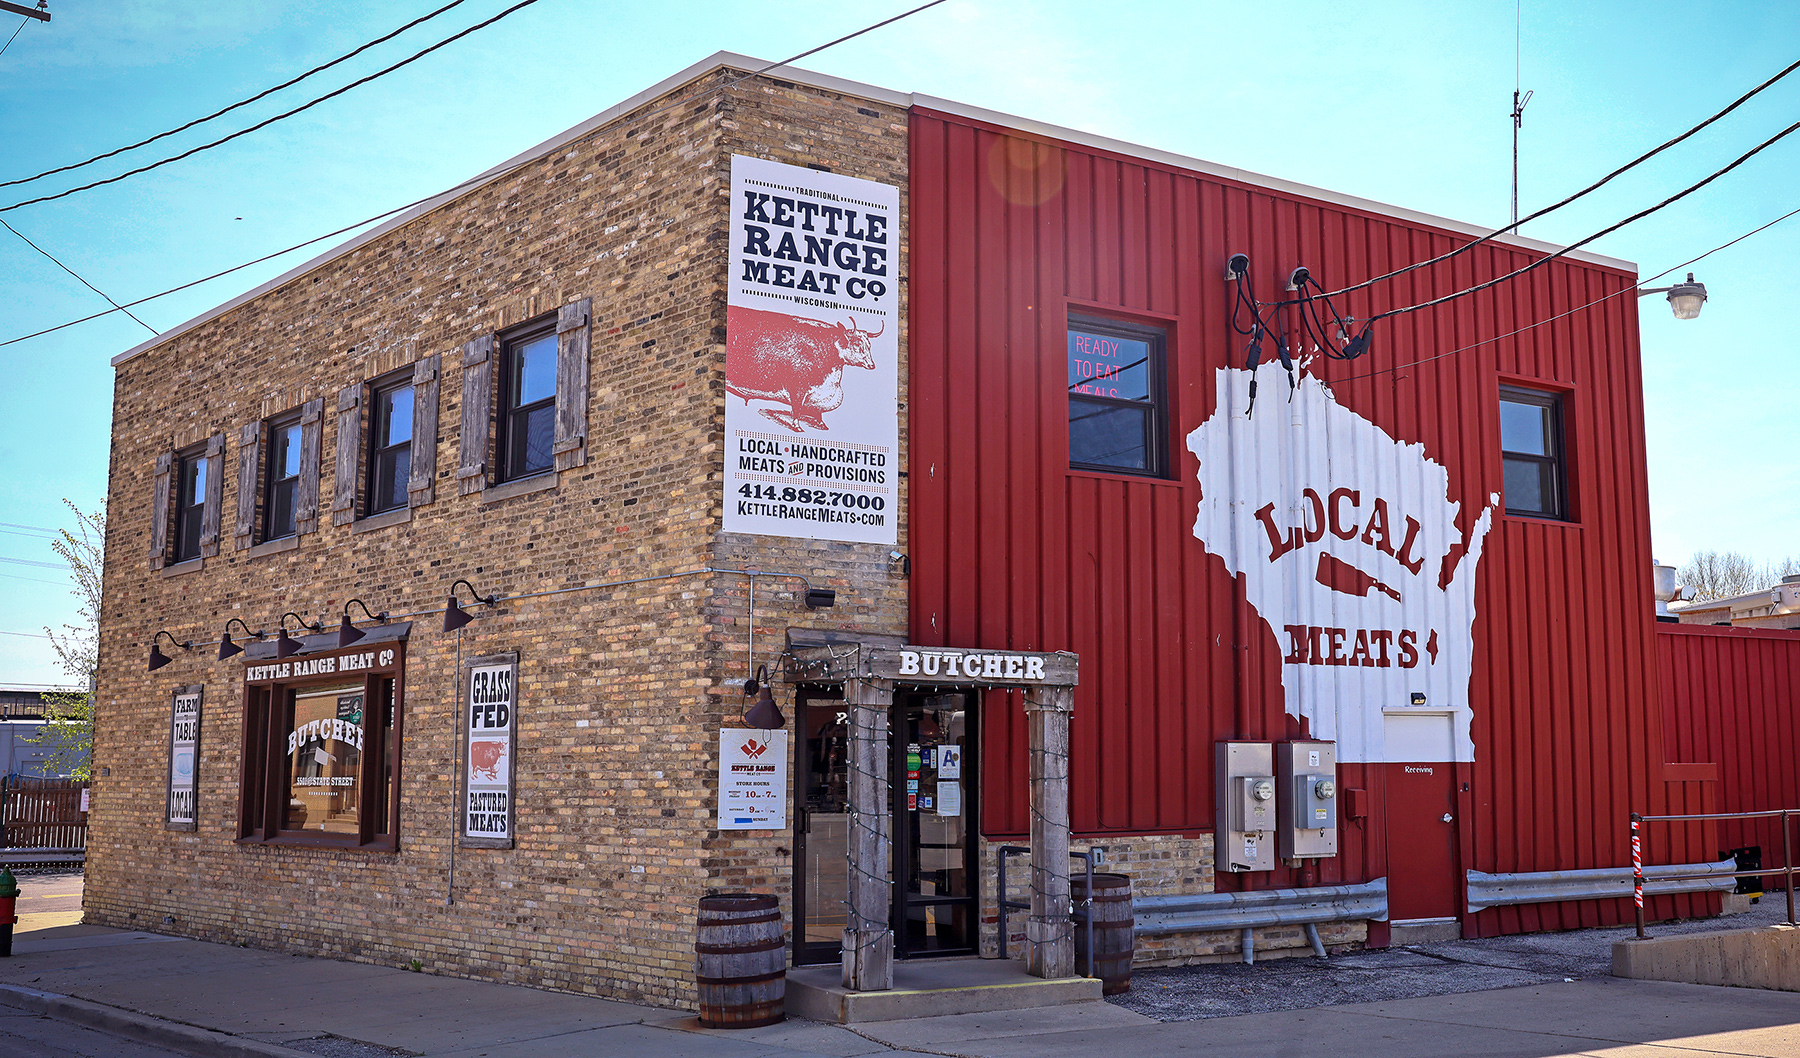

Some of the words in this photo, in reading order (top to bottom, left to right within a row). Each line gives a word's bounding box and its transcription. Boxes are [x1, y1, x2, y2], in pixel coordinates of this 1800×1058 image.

[795, 186, 840, 202] TRADITIONAL
[744, 190, 887, 245] KETTLE
[743, 224, 887, 277] RANGE
[742, 259, 840, 295] MEAT
[794, 296, 838, 309] WISCONSIN
[1076, 335, 1119, 358] READY
[1074, 359, 1092, 378] TO
[1096, 363, 1121, 382] EAT
[739, 438, 782, 456] LOCAL
[791, 444, 886, 467] HANDCRAFTED
[739, 456, 785, 474] MEATS
[788, 462, 804, 475] AND
[806, 463, 885, 484] PROVISIONS
[738, 483, 885, 511] 414.882.7000
[1253, 487, 1425, 576] LOCAL
[1283, 624, 1419, 669] MEATS
[246, 662, 290, 681] KETTLE
[293, 657, 336, 677] RANGE
[339, 652, 375, 672] MEAT
[899, 651, 1045, 680] BUTCHER
[472, 670, 510, 704] GRASS
[176, 698, 197, 714] FARM
[472, 703, 510, 729] FED
[176, 721, 196, 742] TABLE
[943, 749, 956, 767] A
[1404, 765, 1433, 776] Receiving
[312, 776, 330, 786] STATE
[331, 776, 354, 786] STREET
[172, 790, 193, 819] LOCAL
[469, 791, 507, 813] PASTURED
[469, 813, 507, 833] MEATS
